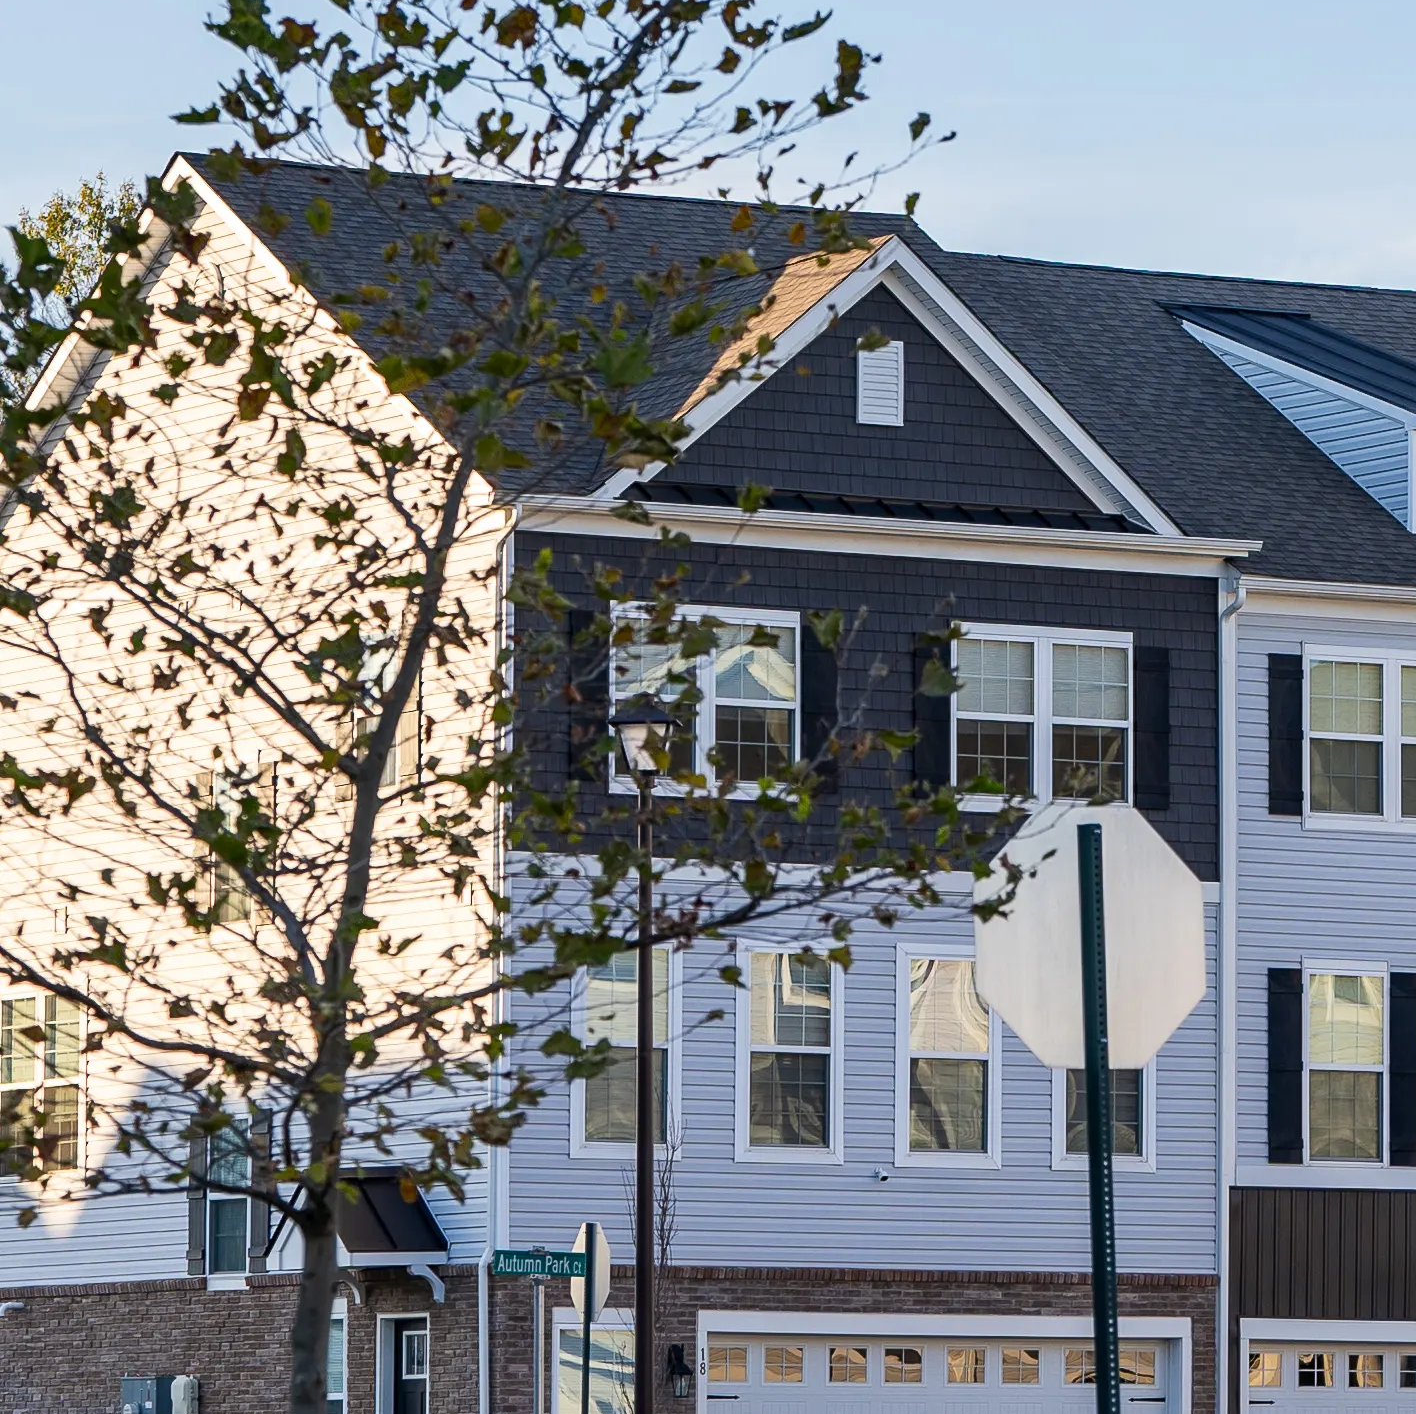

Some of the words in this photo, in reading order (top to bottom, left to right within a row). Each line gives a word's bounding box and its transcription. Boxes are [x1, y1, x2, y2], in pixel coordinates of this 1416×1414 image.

[497, 1254, 542, 1273] Autumn
[545, 1255, 571, 1274] Park
[573, 1261, 582, 1274] Ct
[700, 1347, 706, 1376] 18
